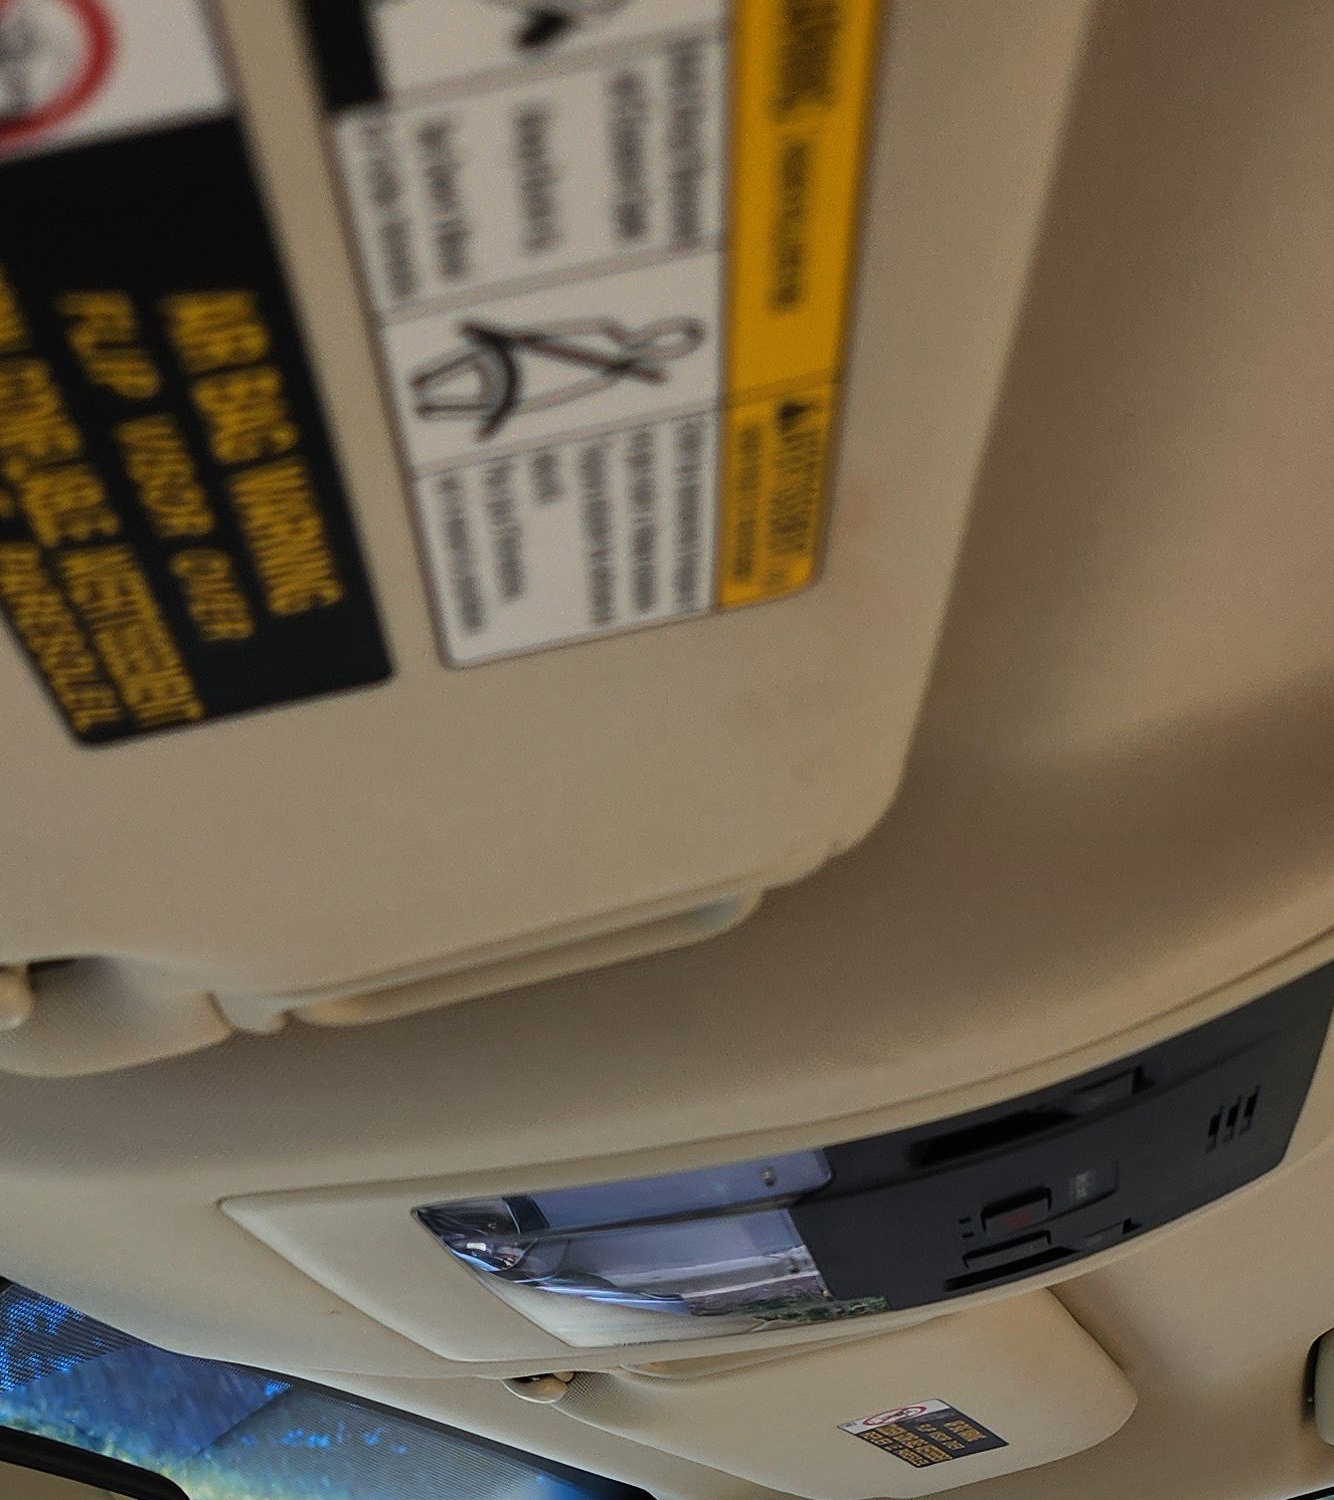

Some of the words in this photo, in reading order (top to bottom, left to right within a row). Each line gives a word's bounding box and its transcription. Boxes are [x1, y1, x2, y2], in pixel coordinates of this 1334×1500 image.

[167, 287, 269, 367] AIR
[59, 289, 160, 399] FLIP
[115, 417, 214, 537] VISOR
[174, 550, 255, 642] OVER
[193, 370, 297, 460] BAG
[230, 465, 344, 613] WARNING
